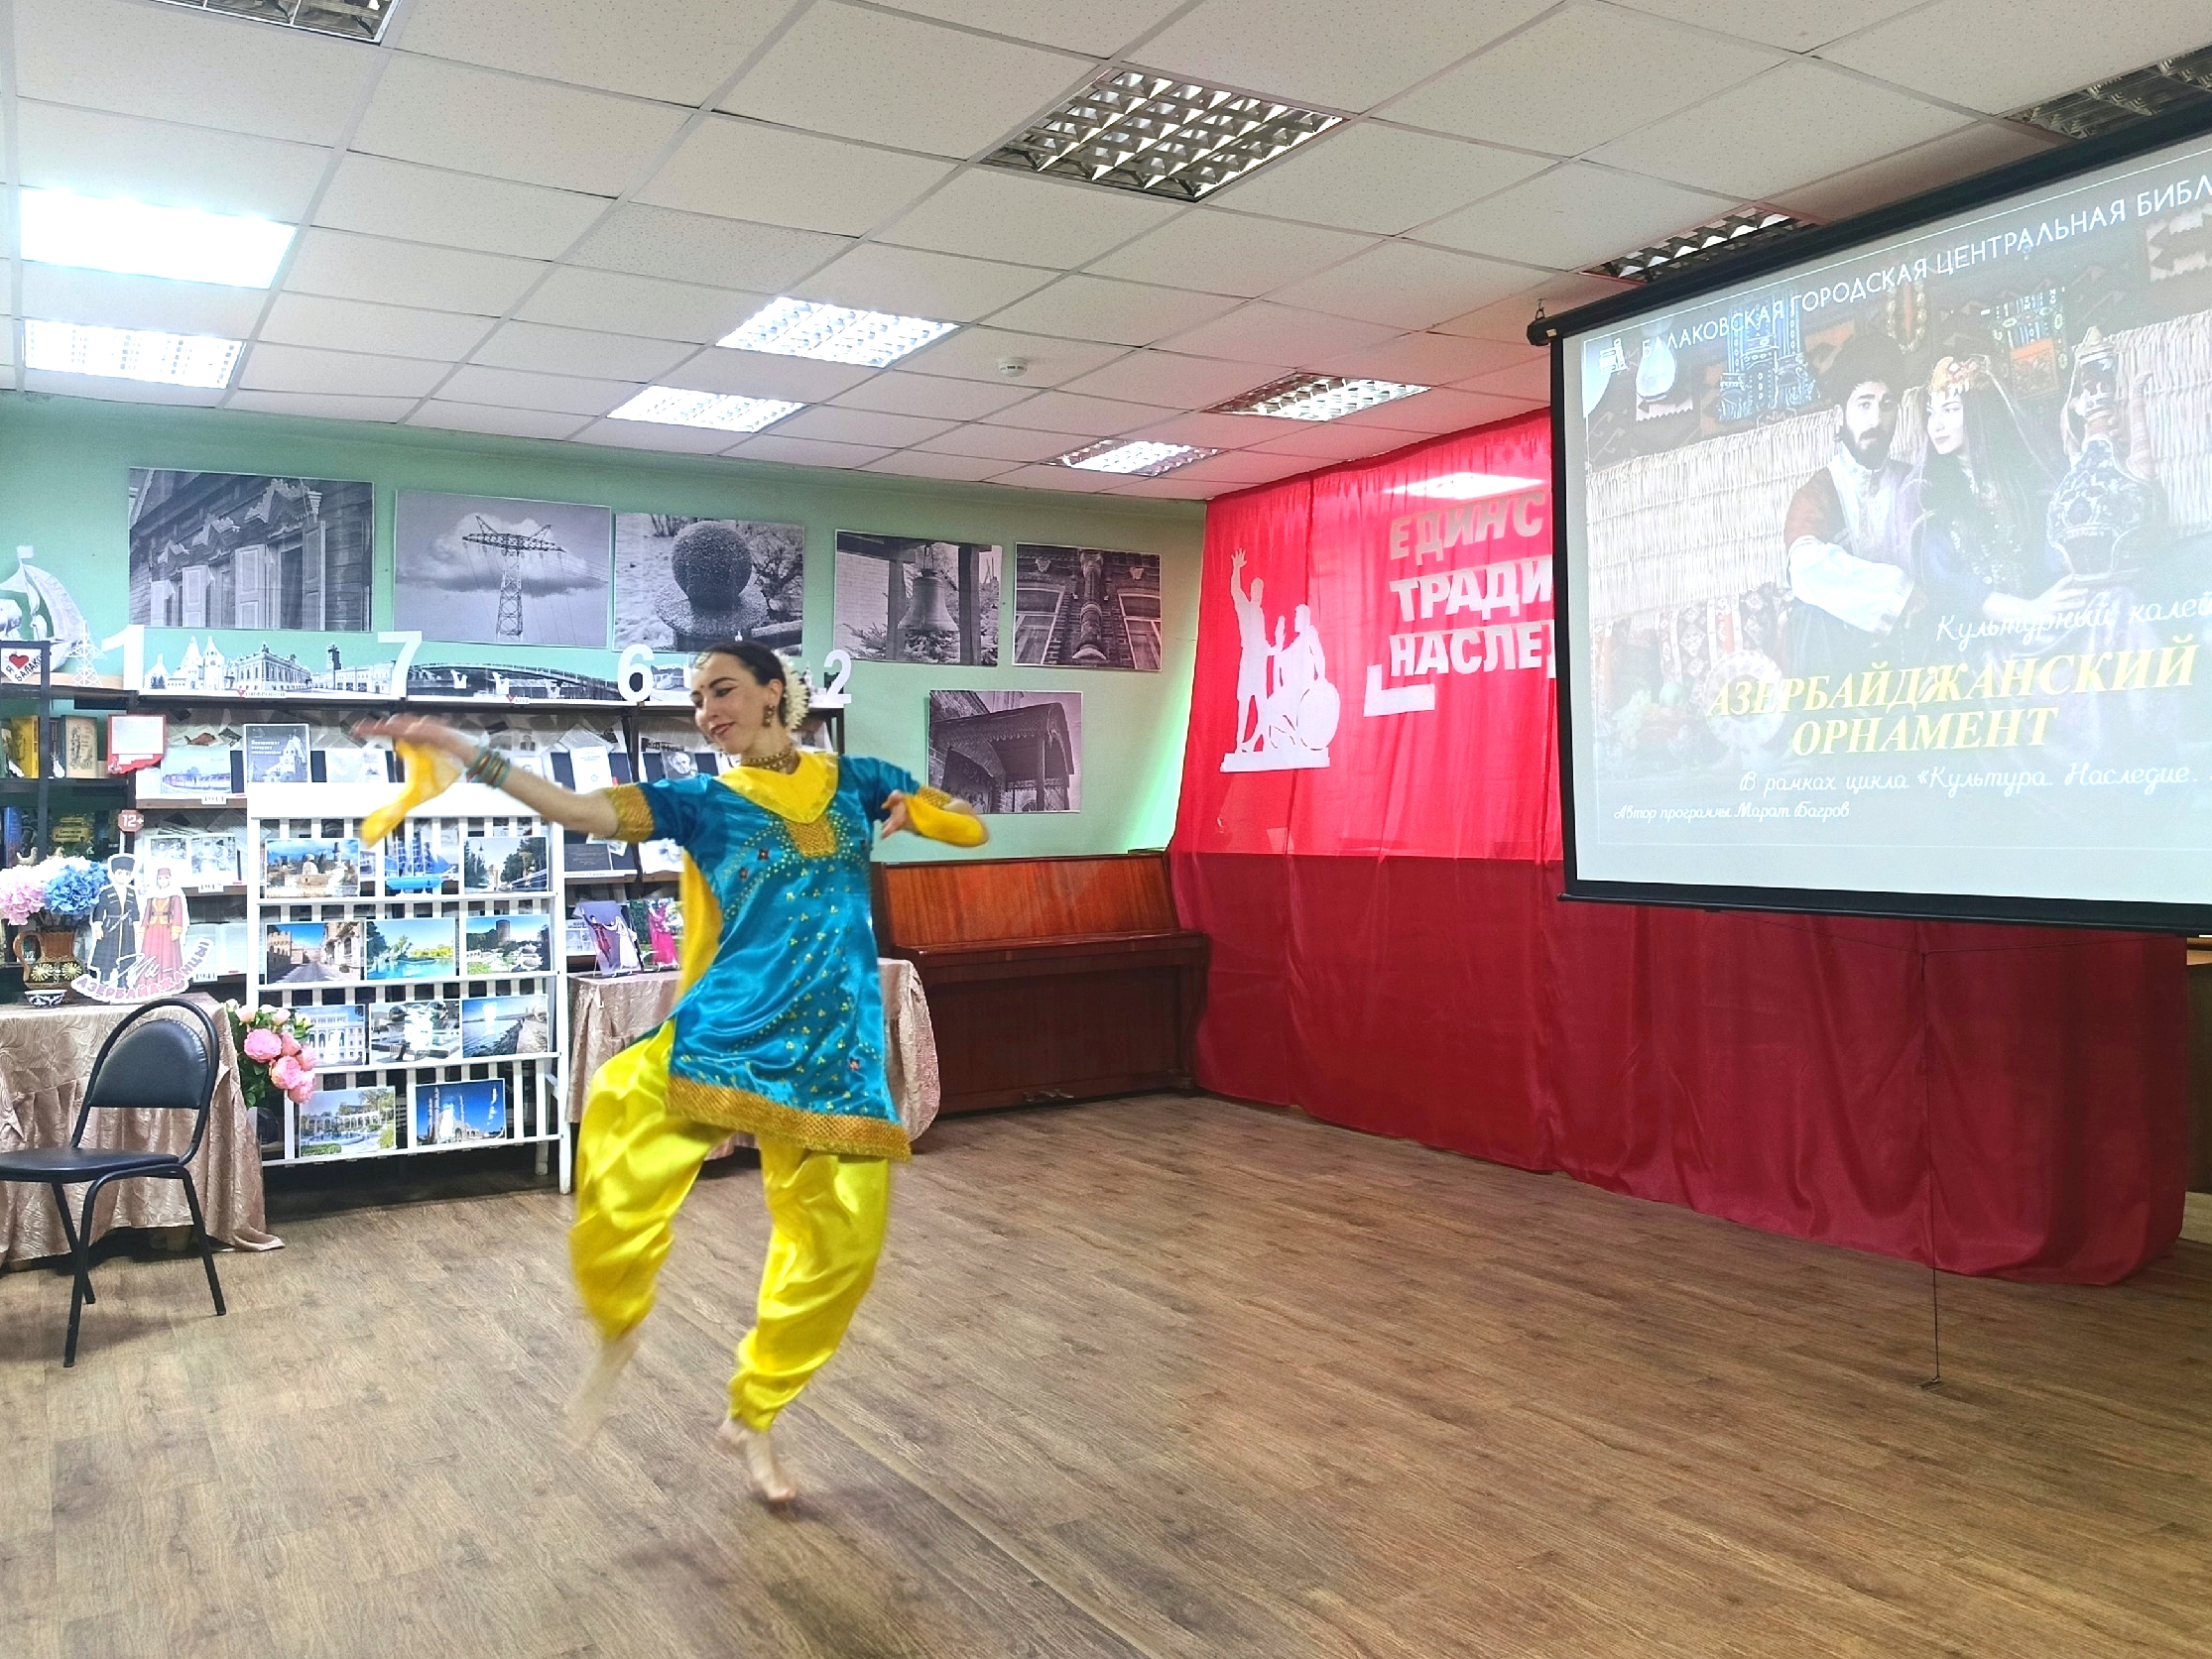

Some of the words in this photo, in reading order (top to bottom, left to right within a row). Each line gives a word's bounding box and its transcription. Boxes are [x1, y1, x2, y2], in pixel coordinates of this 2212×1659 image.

[1642, 299, 1784, 358] БАЛАКОВСКАЯ
[1790, 258, 1927, 316] ГОРОДСКАЯ
[1937, 199, 2126, 275] ЦЕНТРАЛЬНАЯ
[2138, 175, 2212, 217] БИБЛ
[1390, 490, 1545, 566] ЕДИНС
[1390, 554, 1554, 623] ТРАДИ
[1390, 620, 1556, 679] НАСЛЕ
[1936, 601, 2117, 652] Культурный
[6, 664, 15, 674] Я
[1705, 633, 2201, 717] АЗЕРБАЙДЖАНСКИЙ
[1791, 706, 2059, 757] ОРНАМЕНТ
[1739, 770, 1757, 791] В
[1763, 774, 1837, 798] рамках
[1845, 773, 1909, 795] цикла
[2064, 762, 2198, 796] Наследие.
[121, 813, 145, 828] 12+
[1613, 804, 1658, 824] Автор
[1659, 806, 1732, 824] программы
[1734, 802, 1790, 822] Марат
[1792, 800, 1850, 823] Багров
[75, 941, 211, 1000] АЗЕРБАЙДЖАНЦЫ
